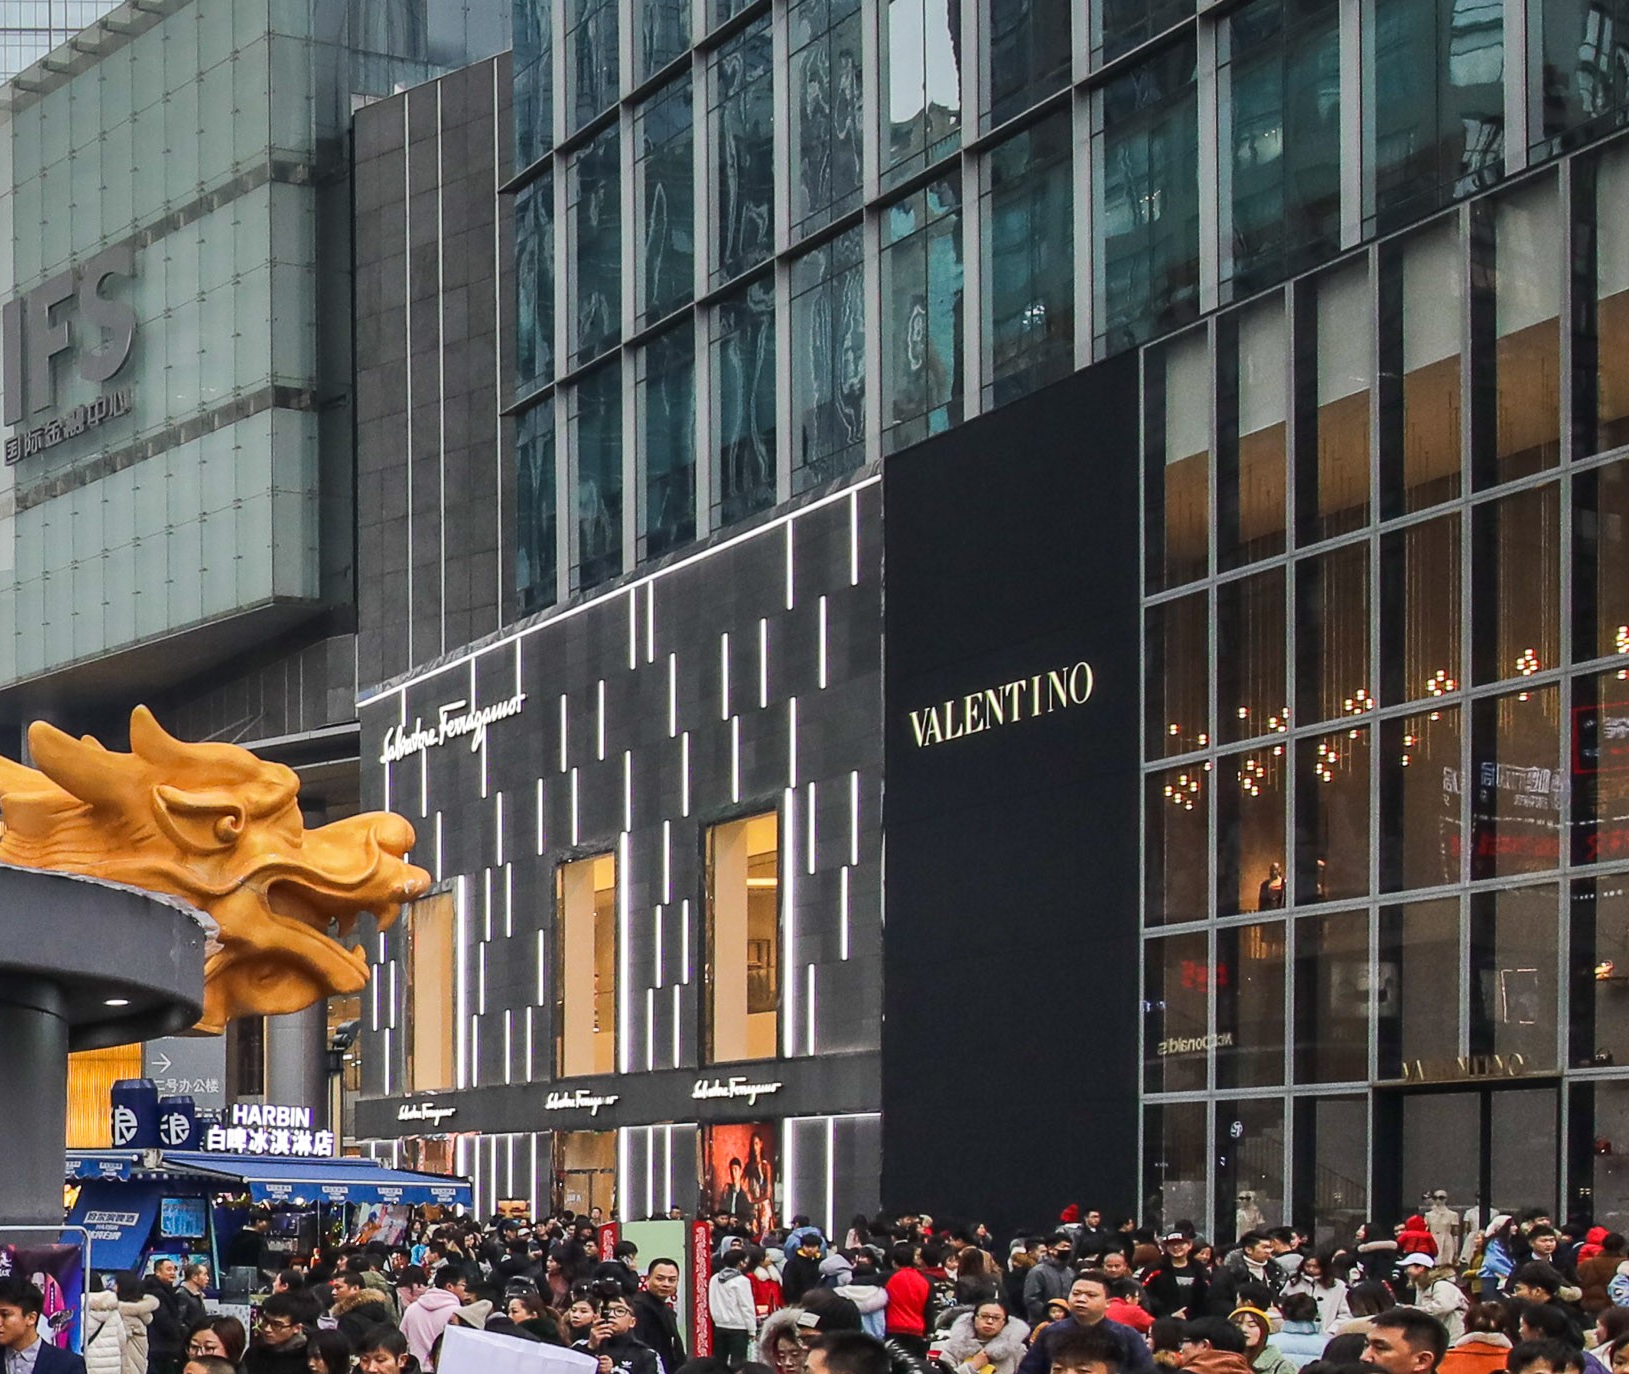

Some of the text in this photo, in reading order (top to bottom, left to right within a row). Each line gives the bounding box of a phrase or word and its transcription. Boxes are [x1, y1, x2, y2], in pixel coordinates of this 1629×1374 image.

[2, 245, 135, 427] IFS
[4, 390, 131, 466] 国际金融中心
[909, 661, 1094, 748] VALENTINO
[379, 717, 439, 764] Salvatore
[206, 1124, 334, 1157] 白啤冰淇淋店
[232, 1103, 312, 1128] HARBIN
